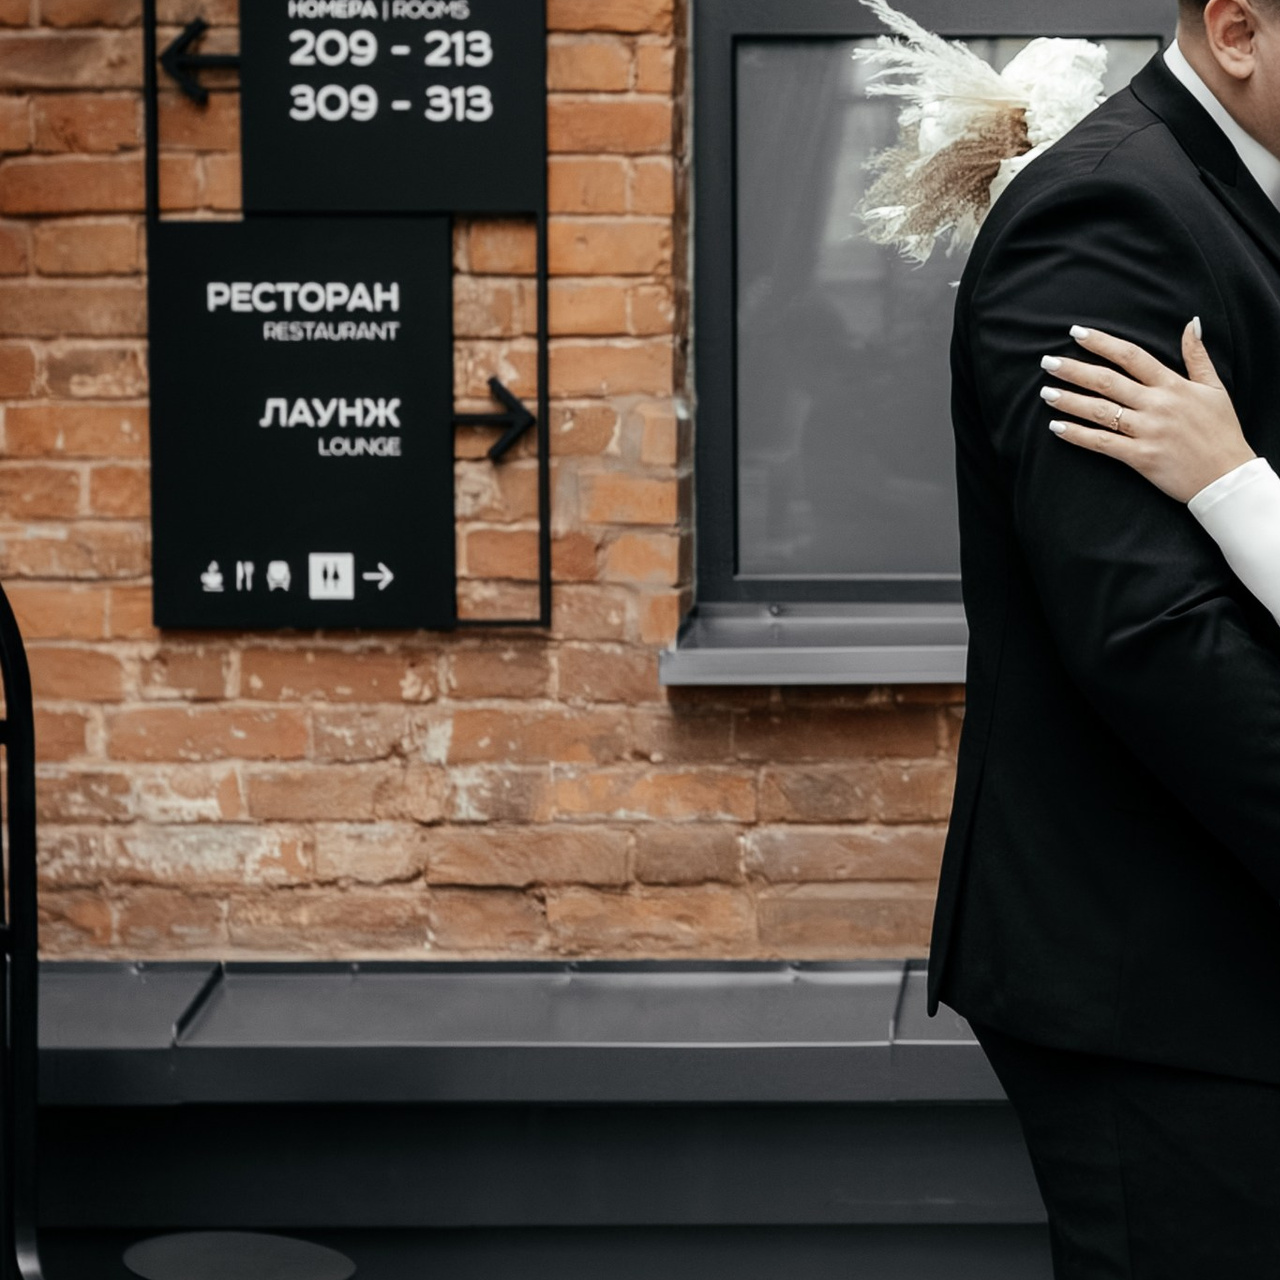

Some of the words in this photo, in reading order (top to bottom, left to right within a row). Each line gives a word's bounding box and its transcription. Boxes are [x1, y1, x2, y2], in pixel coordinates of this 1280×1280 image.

[392, 0, 470, 20] ROOMS
[289, 28, 378, 67] 209
[424, 29, 494, 68] 213
[289, 83, 379, 122] 309
[424, 84, 494, 122] 313
[206, 281, 400, 313] РЕСТОРАН
[263, 321, 401, 341] RESTAURANT
[259, 397, 401, 428] ЛАУНЖ
[318, 436, 402, 457] LOUNGE
